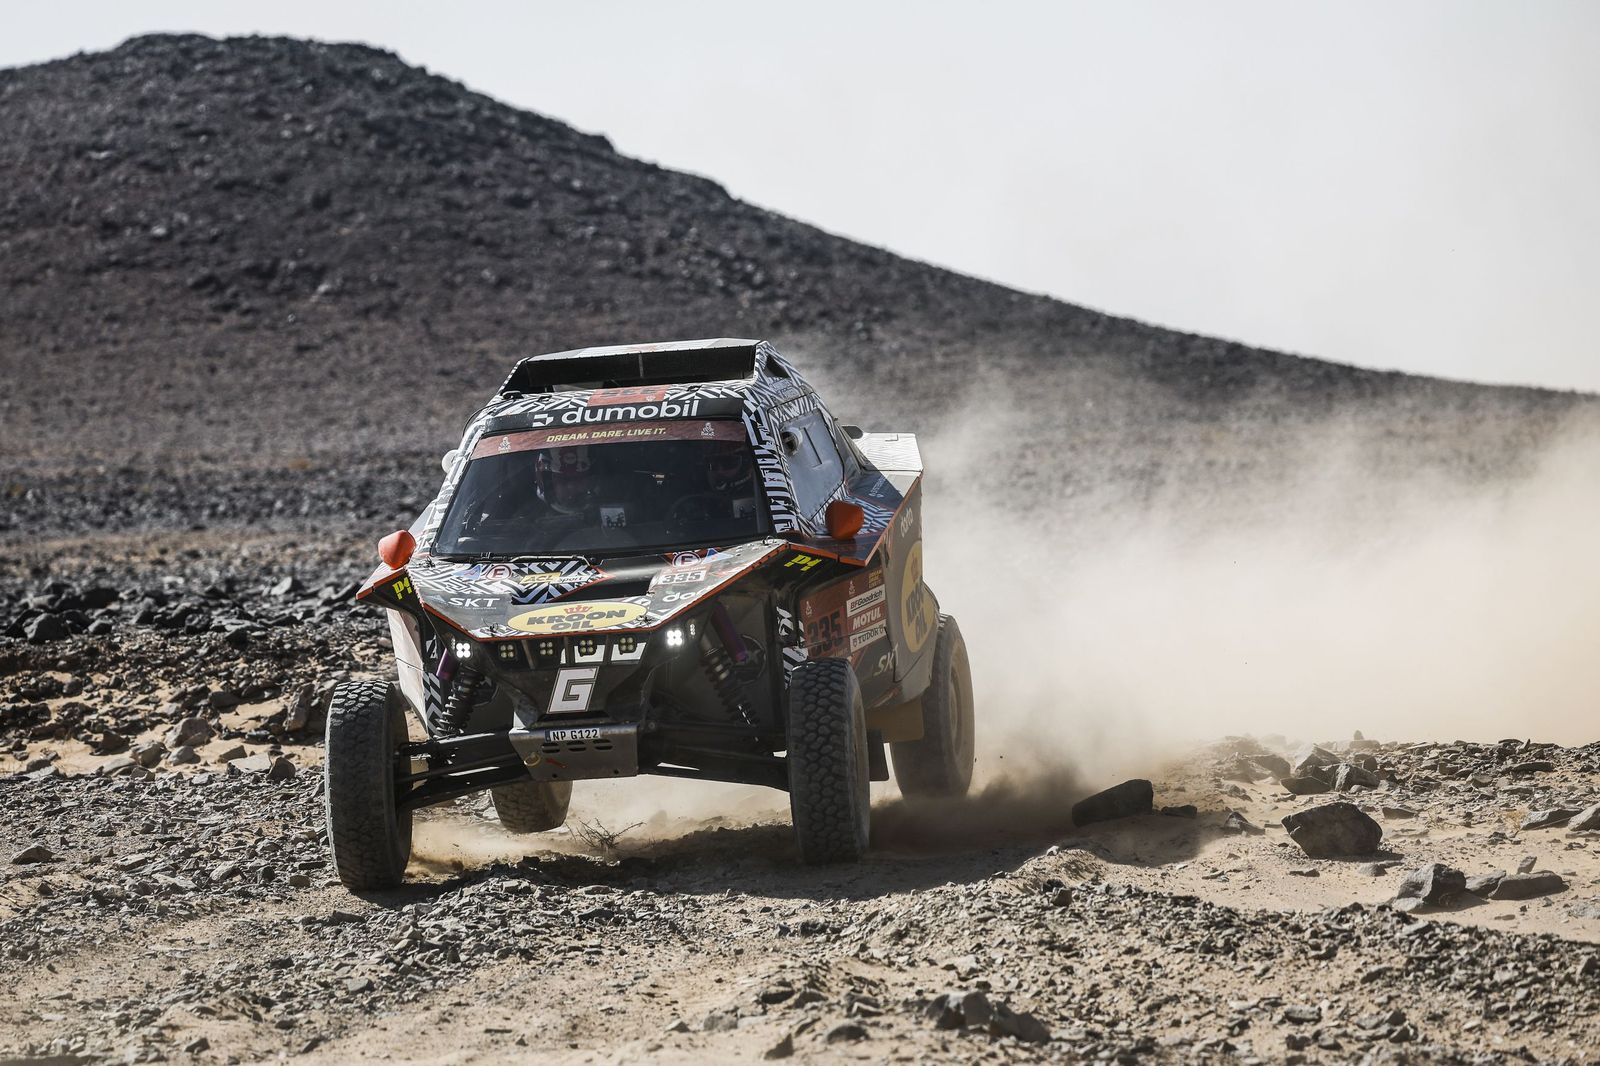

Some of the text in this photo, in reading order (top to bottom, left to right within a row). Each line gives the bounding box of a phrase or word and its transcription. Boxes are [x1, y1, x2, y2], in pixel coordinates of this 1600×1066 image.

[561, 400, 700, 424] dumobil
[546, 427, 667, 443] DREAM. DARE. LIVE IT.
[493, 568, 506, 577] E
[662, 571, 702, 584] 335
[448, 598, 500, 607] SKT
[850, 589, 883, 609] BFGoodrich
[526, 609, 627, 626] KROON
[550, 619, 594, 631] OIL
[852, 607, 881, 631] MOTUL
[807, 610, 844, 655] 335
[857, 627, 879, 643] TUDOR
[873, 643, 899, 677] SKT
[548, 666, 599, 714] G
[552, 729, 599, 741] NP G122
